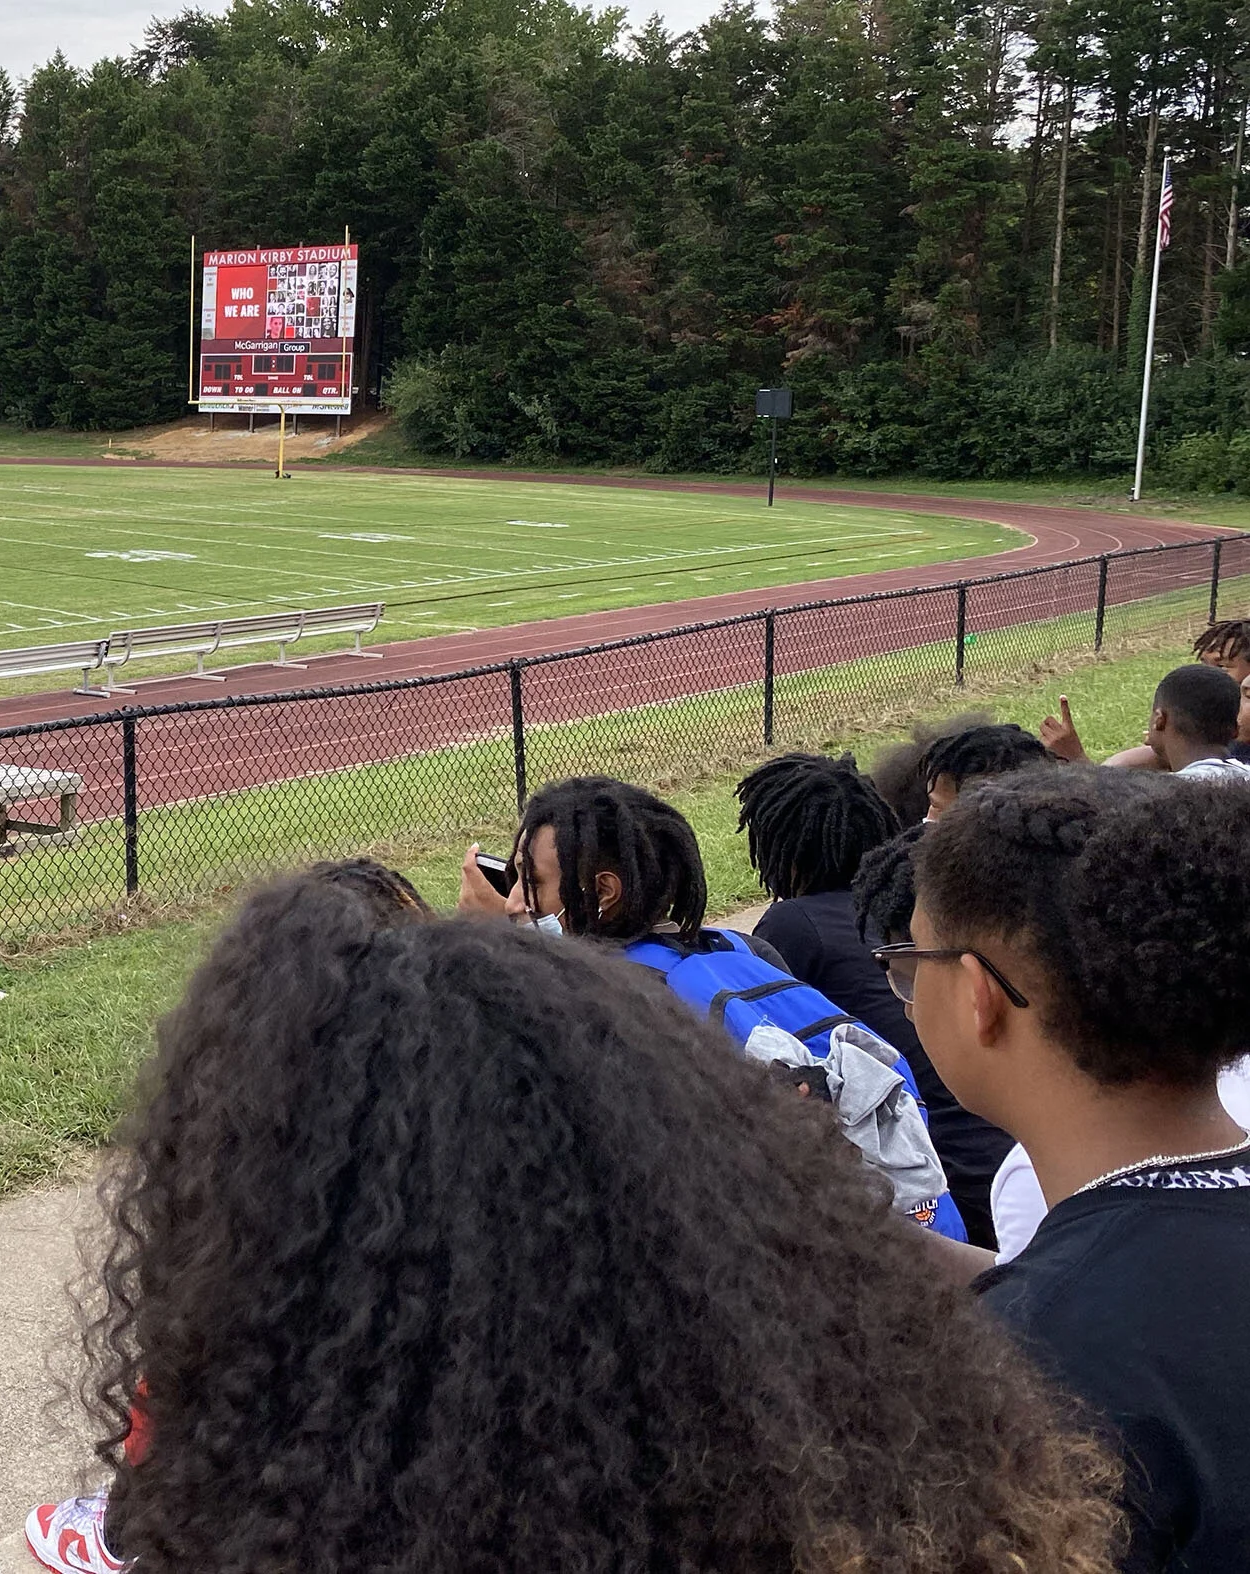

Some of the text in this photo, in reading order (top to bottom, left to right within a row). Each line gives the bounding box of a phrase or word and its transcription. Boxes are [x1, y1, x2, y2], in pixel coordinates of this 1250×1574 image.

[208, 248, 351, 265] MARION KIRBY STADIUM
[231, 287, 254, 300] WHO
[224, 305, 239, 318] WE
[240, 304, 260, 317] ARE
[234, 340, 305, 353] McGarrigan Group
[273, 386, 302, 394] BALL ON
[322, 386, 339, 394] QTR.
